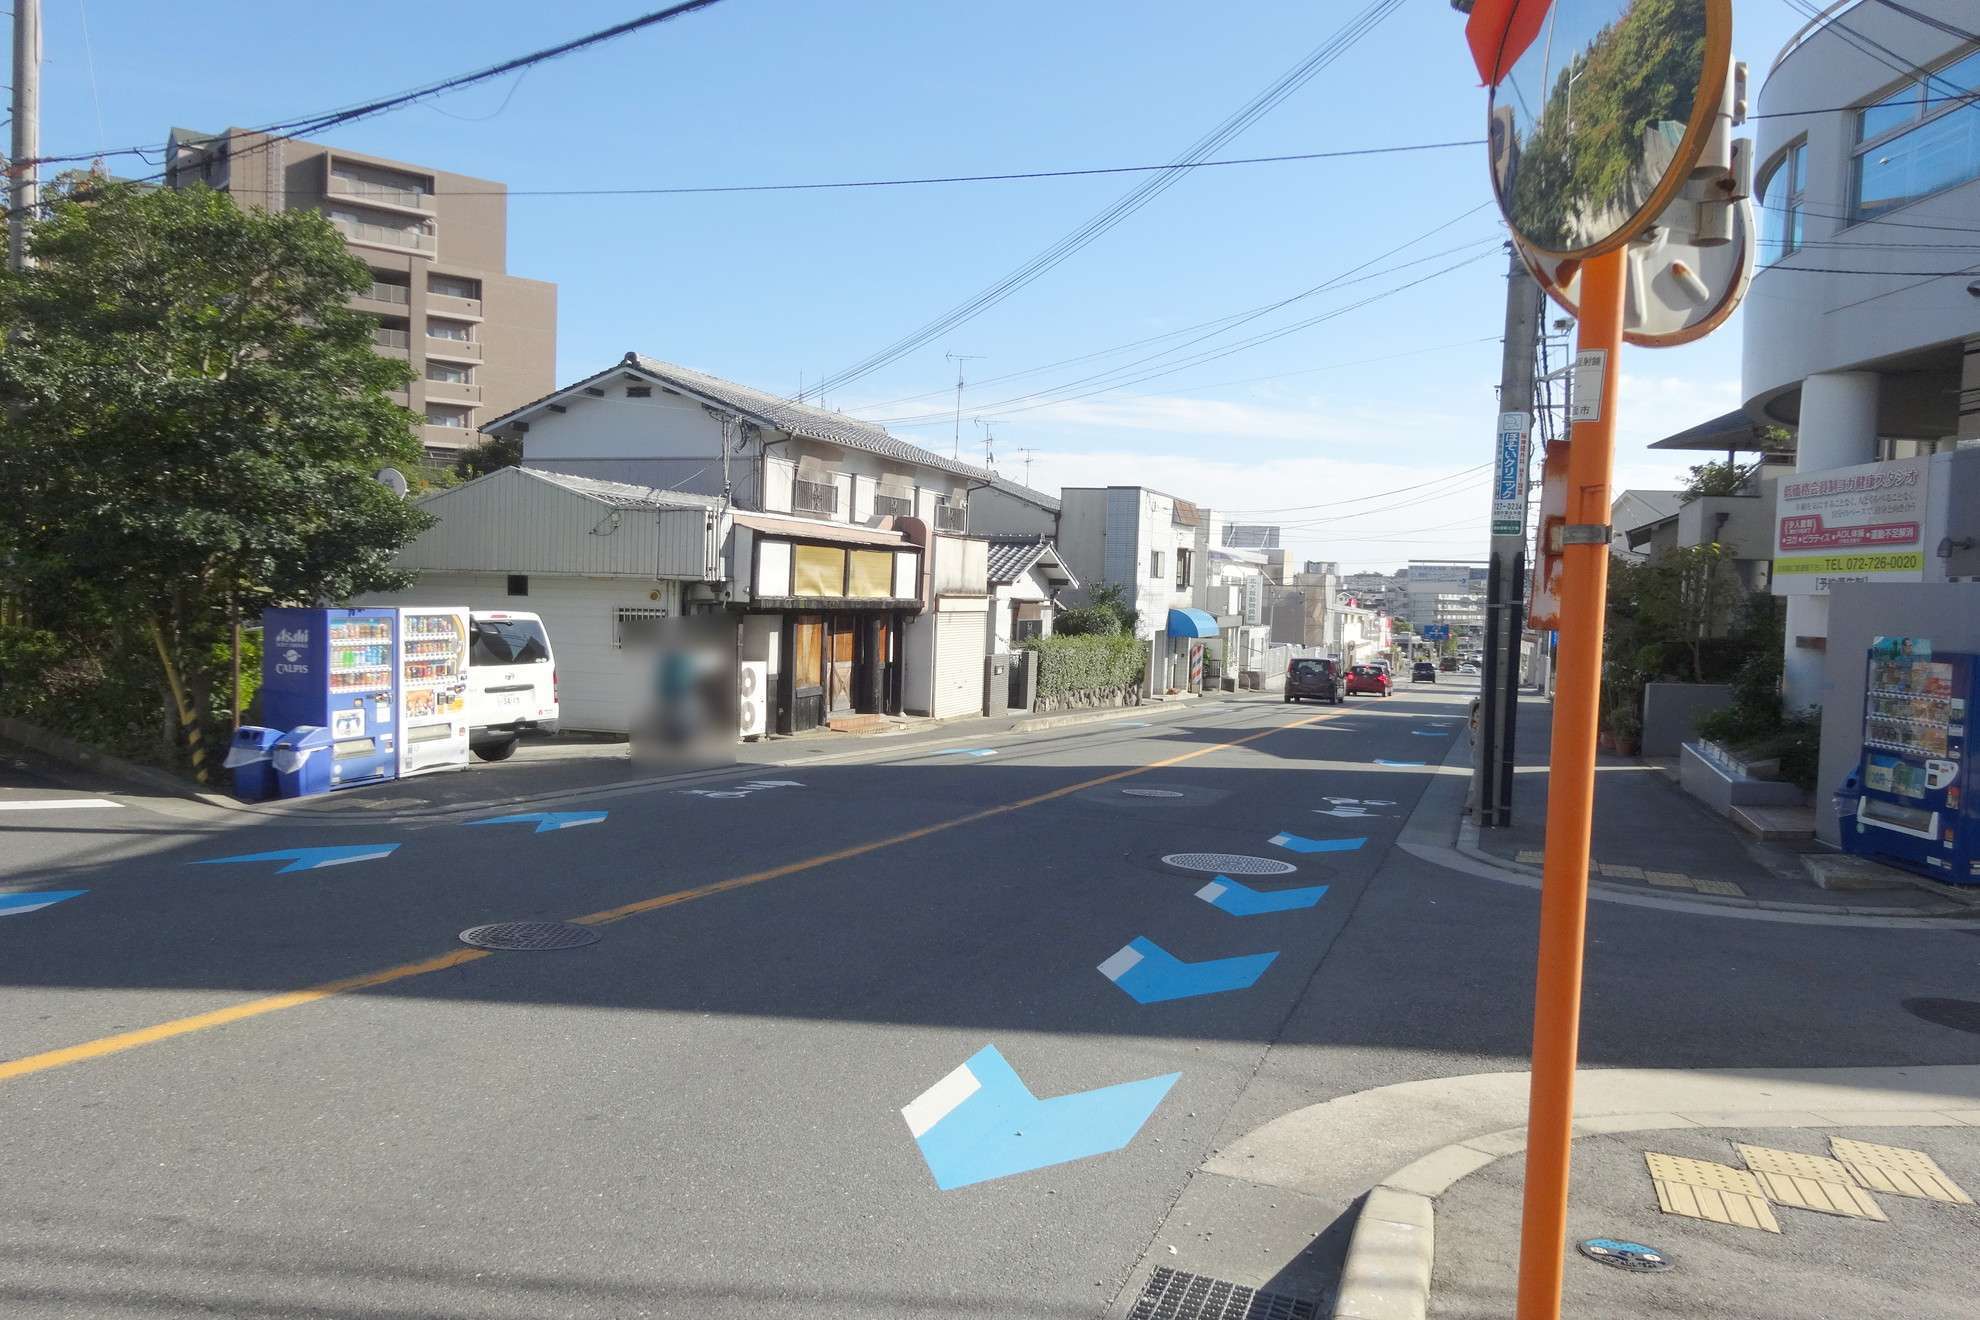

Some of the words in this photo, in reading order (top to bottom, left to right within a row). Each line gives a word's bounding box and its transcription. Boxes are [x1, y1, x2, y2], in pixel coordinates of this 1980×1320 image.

[1825, 559, 1843, 570] TEL
[1846, 556, 1917, 569] 072-726-0020
[275, 628, 309, 643] Asahi
[275, 664, 309, 675] CALPIS
